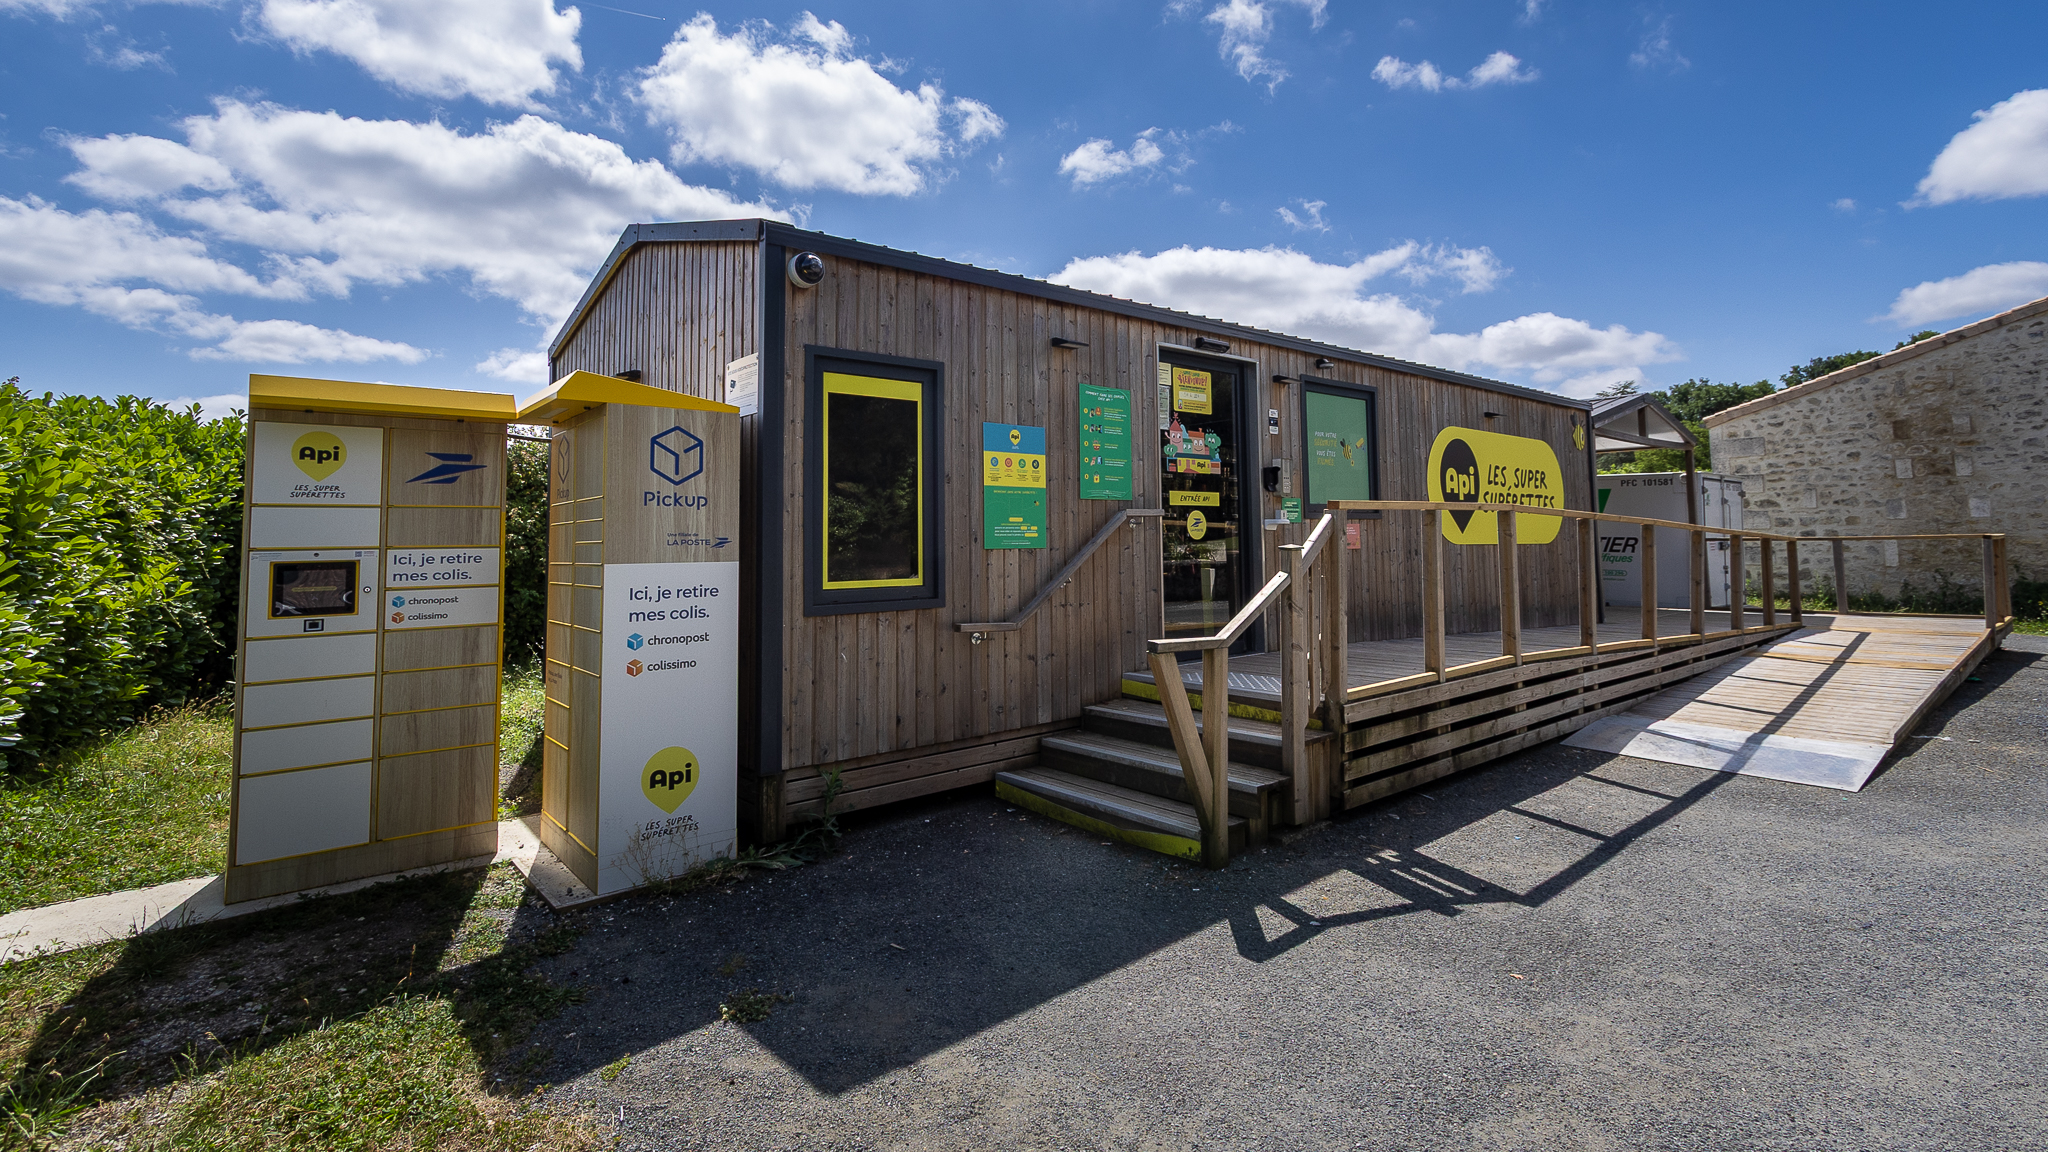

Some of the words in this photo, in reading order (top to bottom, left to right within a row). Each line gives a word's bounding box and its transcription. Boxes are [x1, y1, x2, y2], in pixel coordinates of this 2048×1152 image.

[299, 445, 340, 464] Api
[1197, 461, 1206, 469] Api
[1446, 466, 1475, 500] Api
[1488, 464, 1506, 487] LES
[1514, 467, 1547, 490] SUPER
[1620, 479, 1638, 487] PFC
[1641, 477, 1673, 487] 101581
[290, 488, 345, 498] SUPÉRETTES
[644, 491, 708, 510] Pickup
[1180, 494, 1202, 502] ENTRÉE
[393, 553, 416, 566] Ici,
[419, 553, 435, 567] je
[440, 552, 482, 564] retire
[393, 572, 428, 581] mes
[432, 569, 472, 580] colis.
[408, 596, 459, 605] chronopost
[629, 585, 653, 602] Ici,
[655, 585, 672, 603] je
[676, 584, 720, 599] retire
[408, 612, 448, 621] colissimo
[629, 610, 666, 622] mes
[670, 605, 710, 620] colis.
[647, 632, 710, 646] chronopost
[647, 659, 697, 672] colissimo
[649, 762, 692, 790] Api
[645, 821, 661, 831] LES
[666, 814, 694, 827] SUPER
[641, 822, 700, 841] SUPÉRETTES
